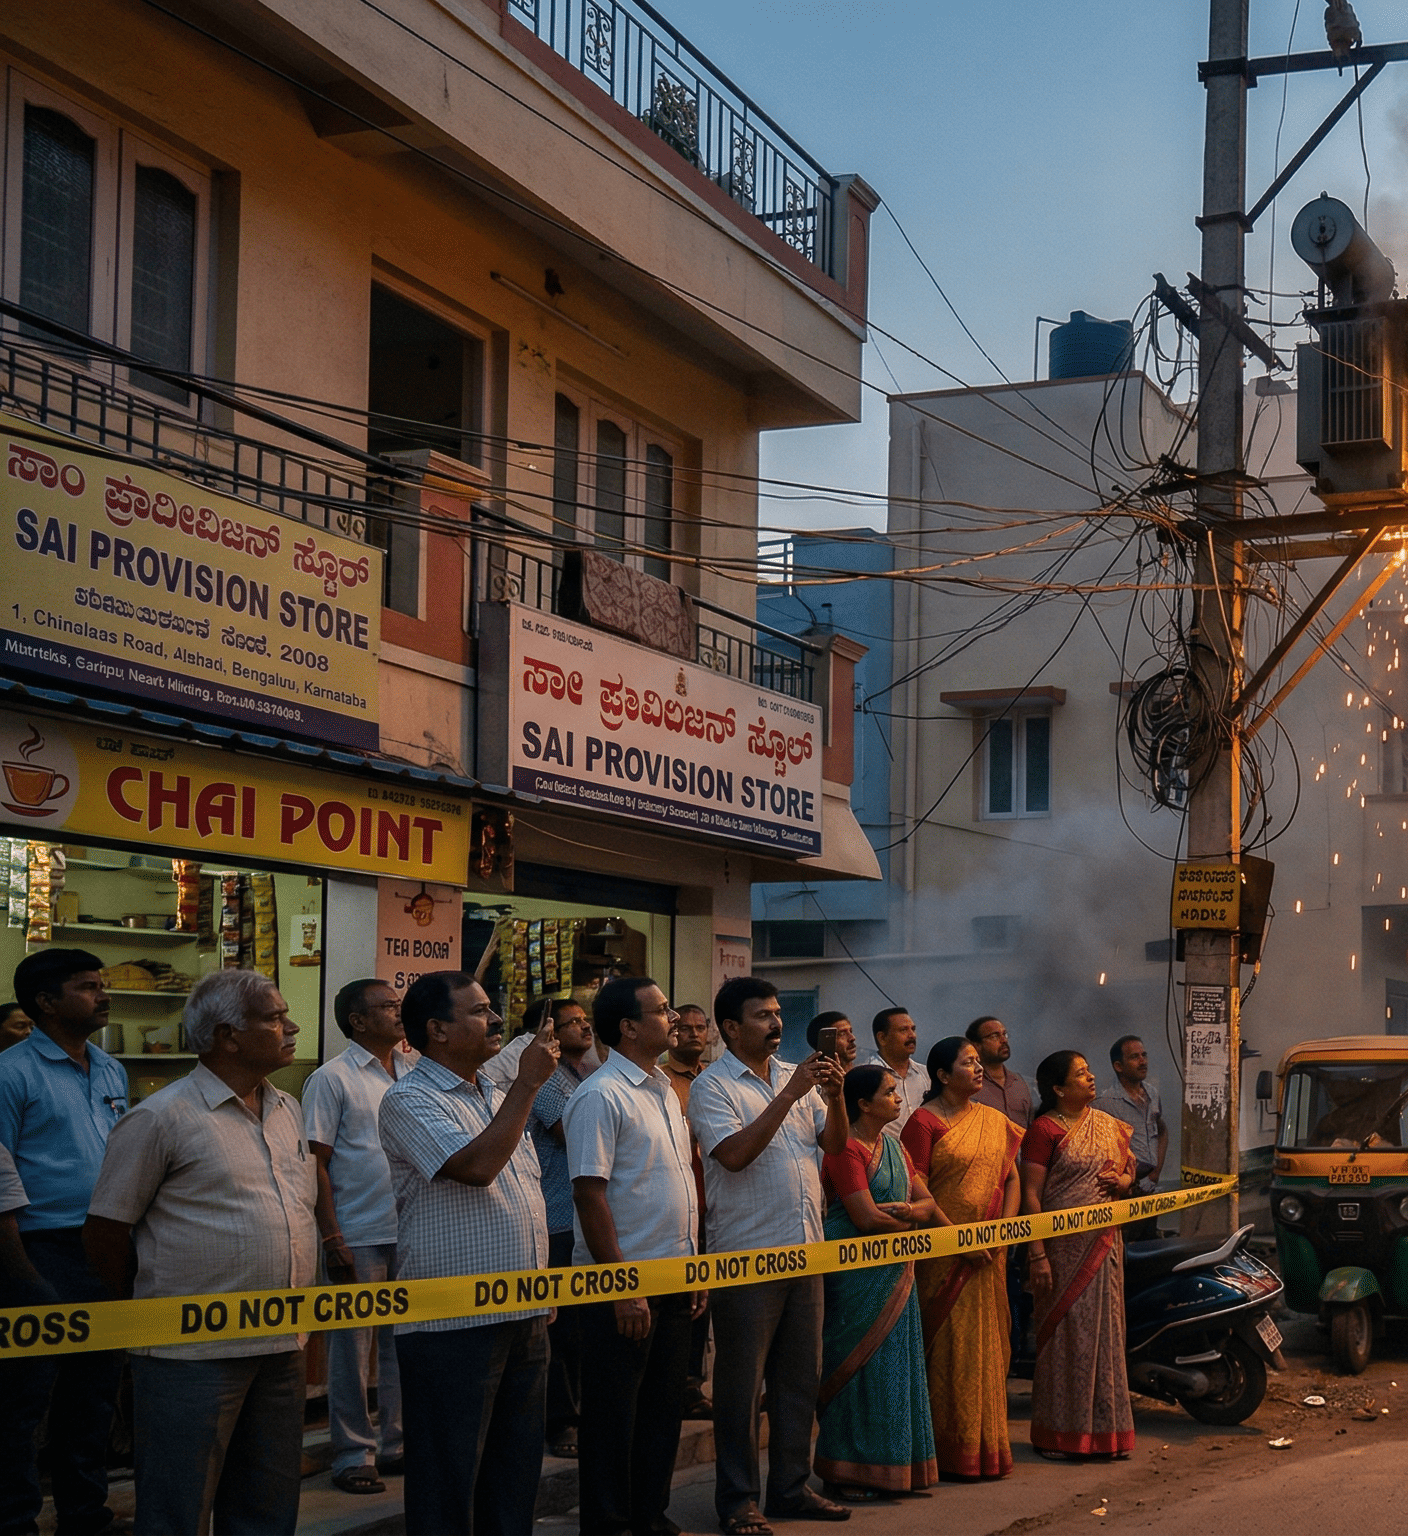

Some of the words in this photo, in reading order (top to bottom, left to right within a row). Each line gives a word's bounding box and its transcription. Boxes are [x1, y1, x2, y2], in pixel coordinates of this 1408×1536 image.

[15, 508, 77, 564] SAI
[90, 530, 269, 621] PROVISION
[279, 590, 369, 650] STORE
[123, 632, 168, 660] Road,
[280, 644, 329, 672] 2008
[522, 721, 573, 767] SAI
[586, 736, 733, 804] PROVISION
[741, 776, 814, 822] STORE
[106, 766, 256, 840] CHAI
[280, 792, 443, 866] POINT
[385, 937, 409, 957] TEA
[958, 1228, 973, 1247] DO
[976, 1224, 997, 1244] NOT
[1000, 1220, 1032, 1241] CROSS
[1052, 1215, 1065, 1232] DO
[1067, 1211, 1085, 1229] NOT
[1086, 1206, 1113, 1225] CROSS
[838, 1243, 858, 1265] DO
[862, 1238, 889, 1262] NOT
[892, 1233, 932, 1257] CROSS
[685, 1260, 710, 1284] DO
[715, 1256, 750, 1281] NOT
[755, 1250, 807, 1276] CROSS
[475, 1278, 508, 1307] DO
[516, 1274, 563, 1302] NOT
[570, 1266, 639, 1297] CROSS
[181, 1301, 228, 1334] DO
[239, 1295, 305, 1329] NOT
[314, 1287, 409, 1322] CROSS
